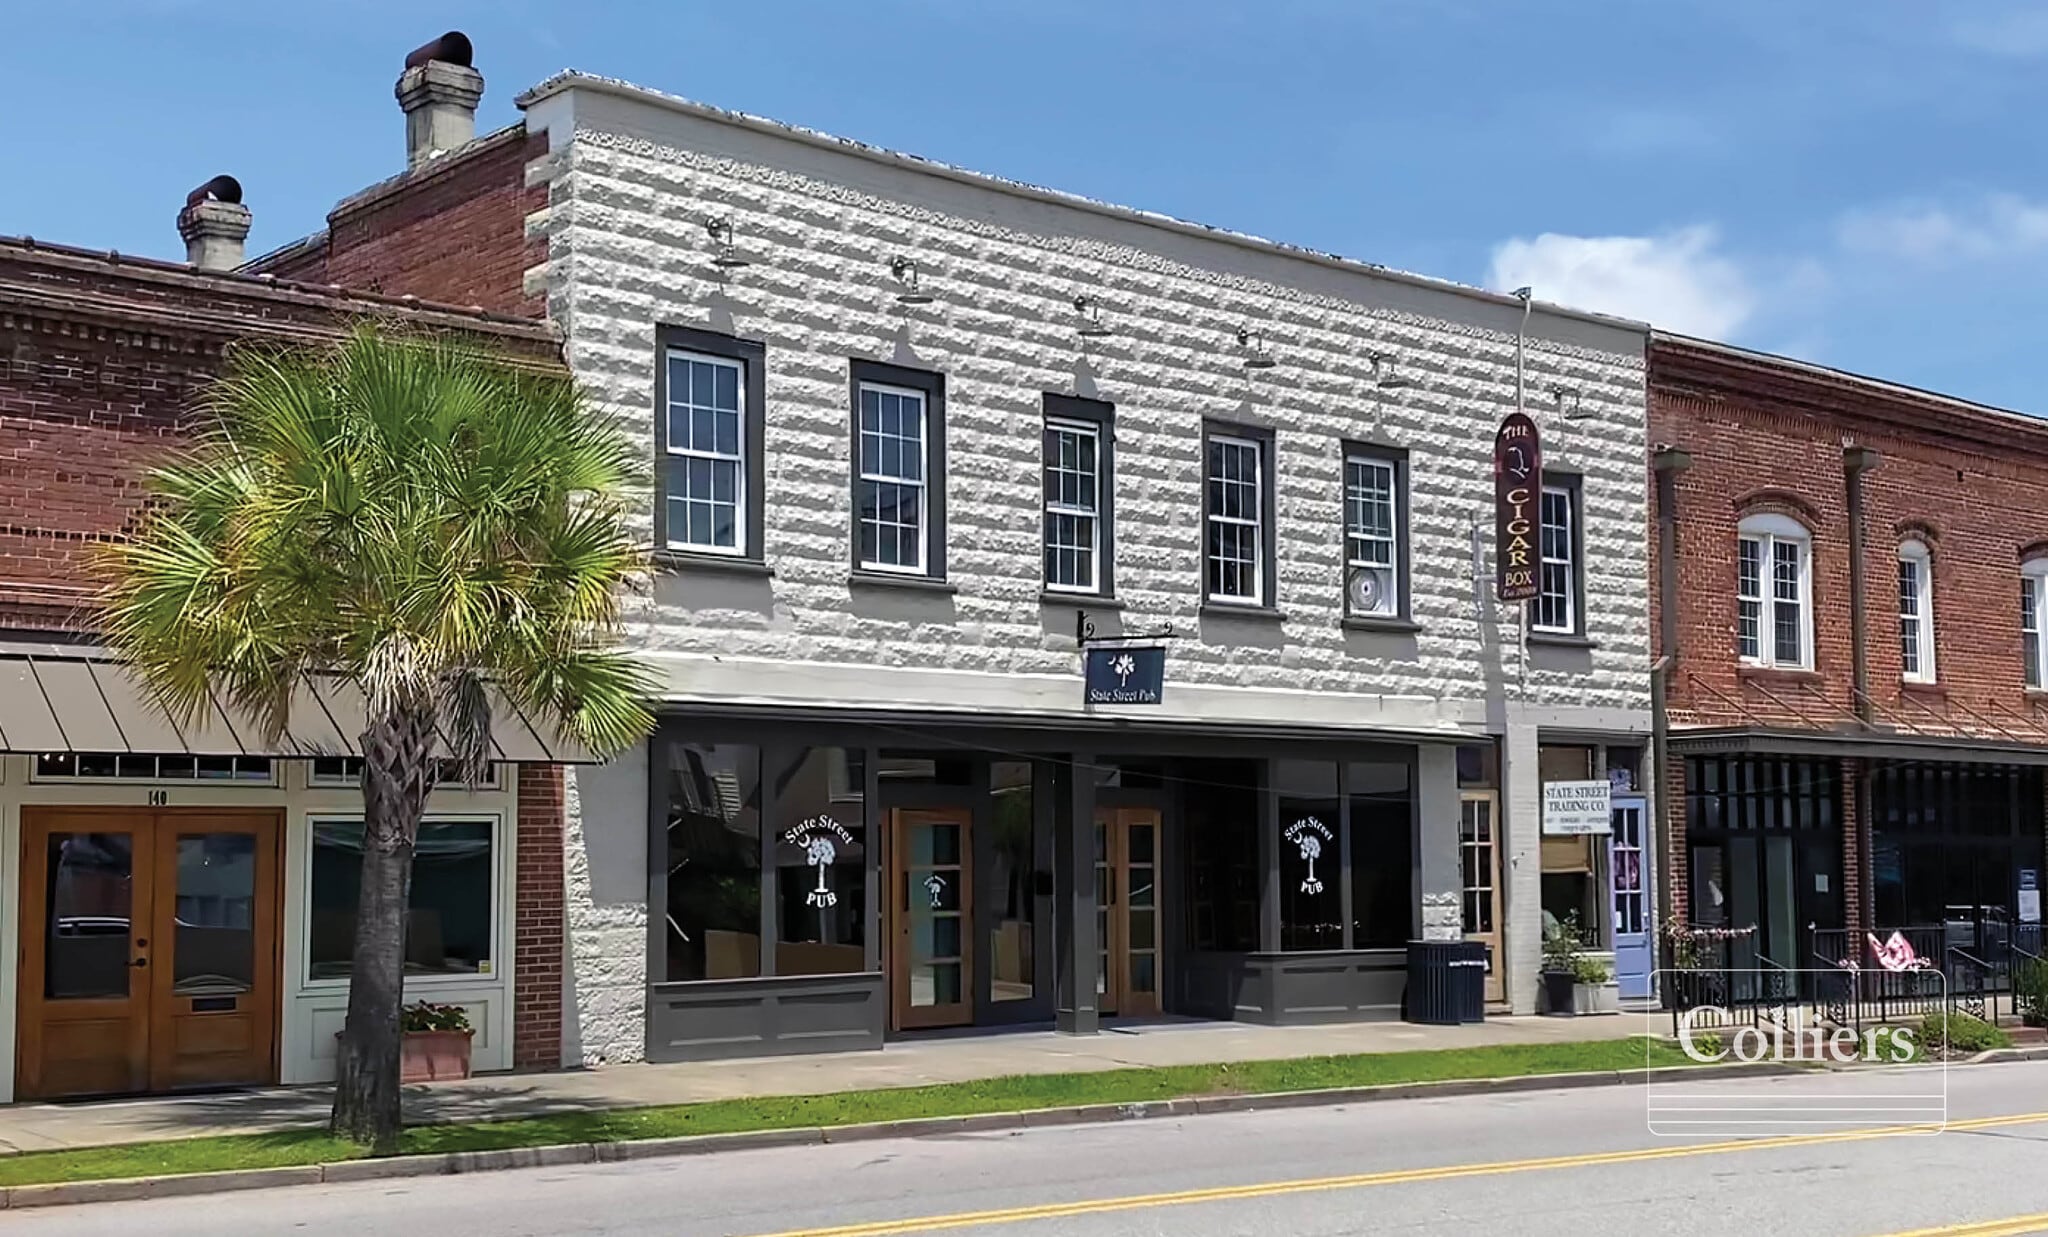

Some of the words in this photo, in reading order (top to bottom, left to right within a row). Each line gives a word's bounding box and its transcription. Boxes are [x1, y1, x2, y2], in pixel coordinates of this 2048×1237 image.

[1502, 424, 1529, 440] THE
[1506, 488, 1532, 567] CIGAR
[1505, 570, 1532, 587] BOX
[1090, 688, 1111, 701] State
[1112, 688, 1138, 701] Street
[1139, 688, 1156, 701] Pub
[149, 790, 167, 805] 140
[1546, 787, 1573, 798] STATE
[1574, 786, 1608, 798] STREET
[1549, 801, 1590, 812] TRADING
[785, 818, 817, 844] State
[818, 814, 854, 845] Street
[1284, 819, 1306, 841] State
[1307, 815, 1333, 841] Street
[1300, 881, 1324, 895] PUB
[806, 892, 837, 908] PUB
